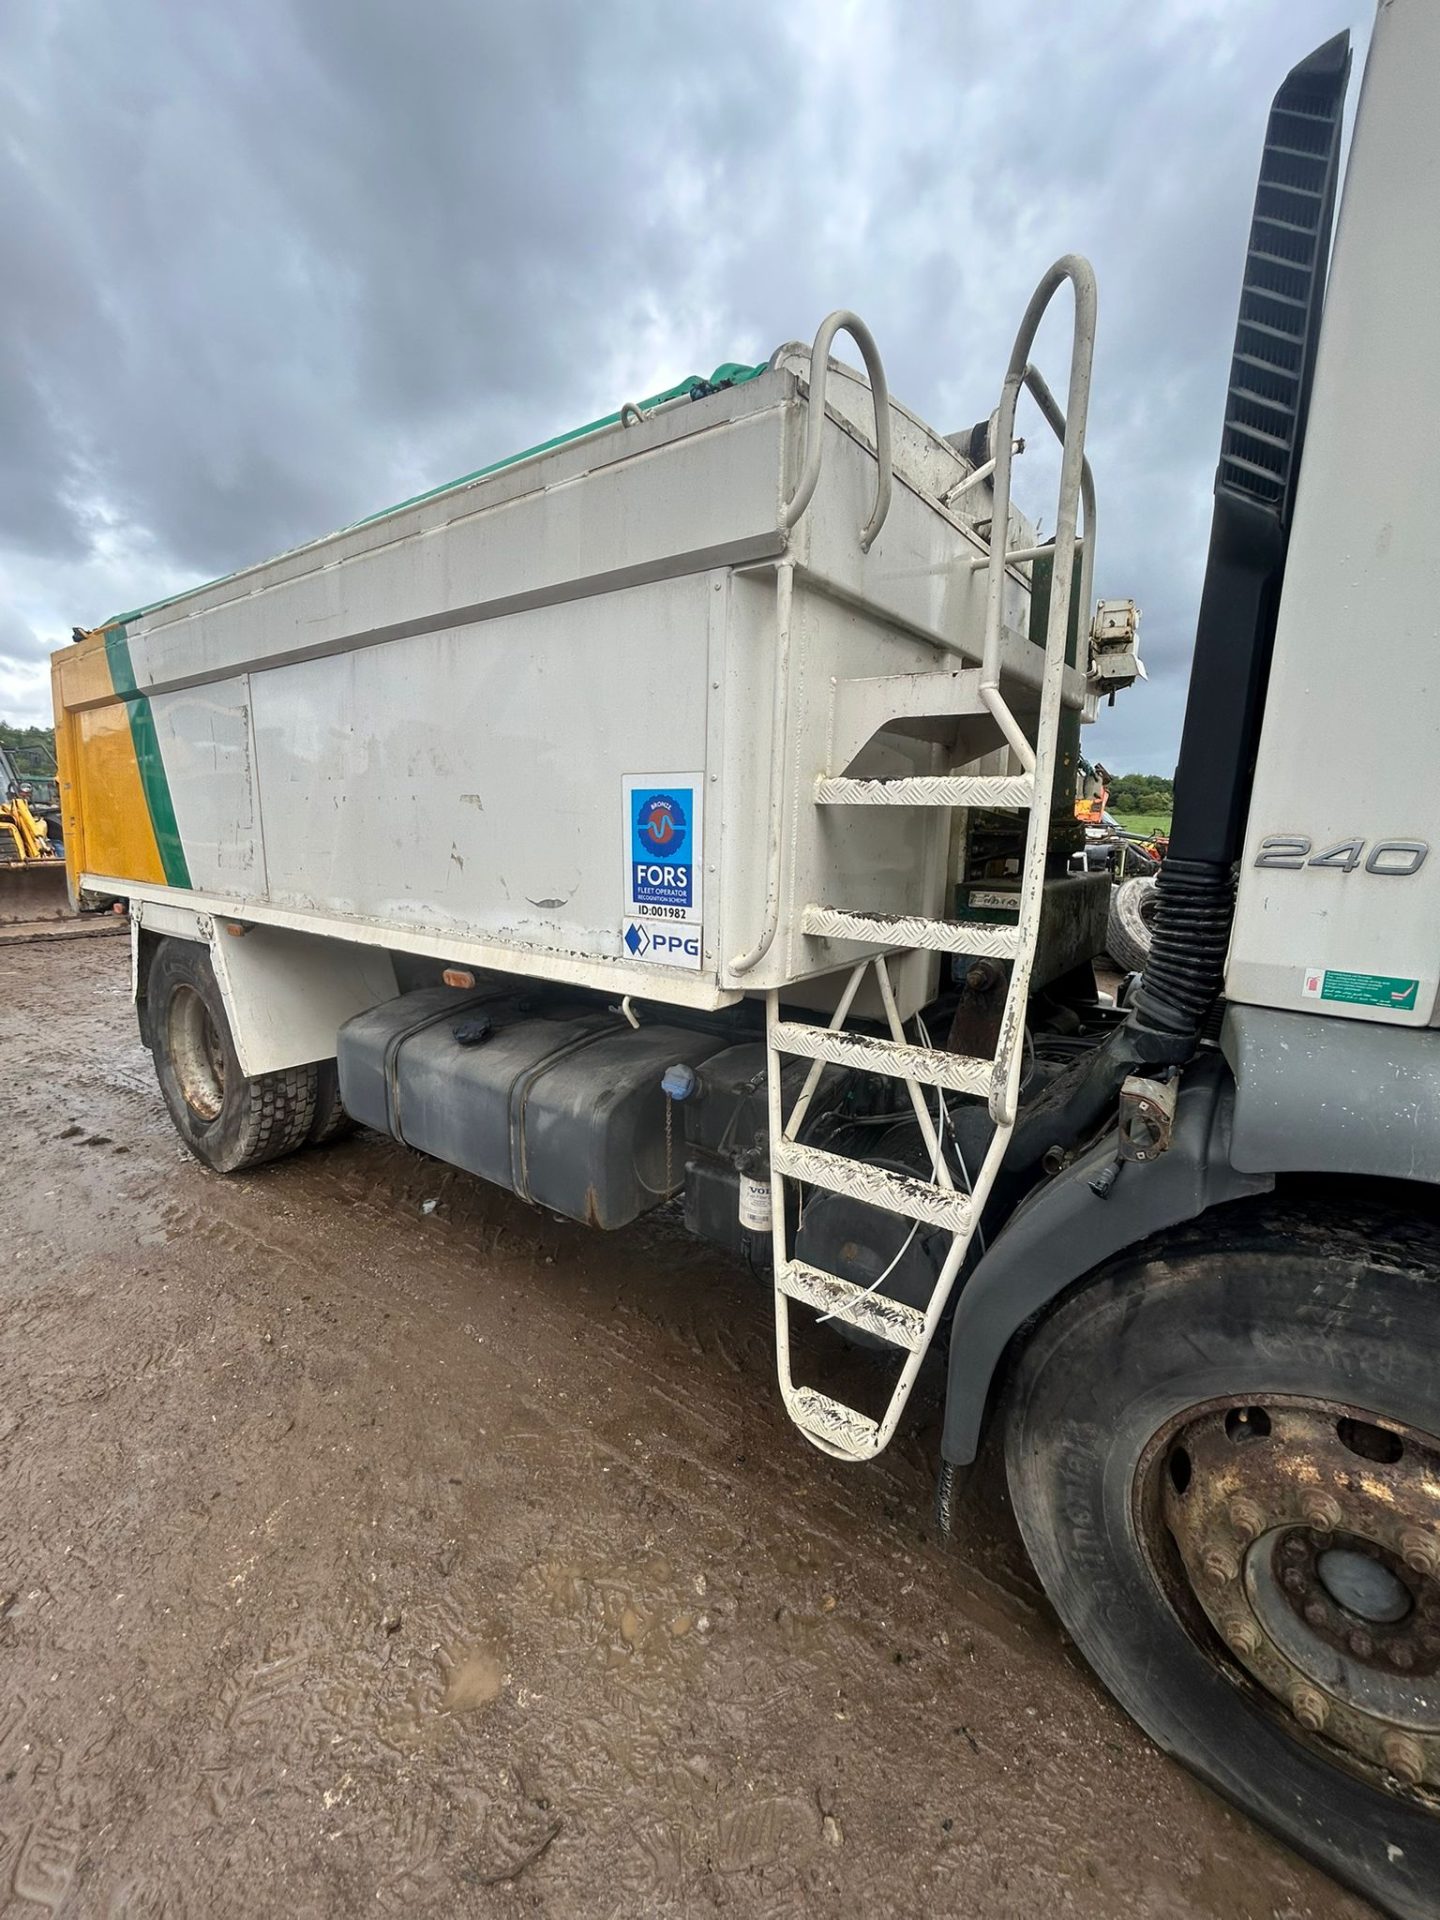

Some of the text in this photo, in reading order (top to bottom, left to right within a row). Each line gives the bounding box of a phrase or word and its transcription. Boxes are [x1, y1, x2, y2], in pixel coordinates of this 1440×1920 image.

[651, 801, 671, 811] BRONZE
[1254, 836, 1429, 876] 240
[637, 864, 688, 888] FORS
[637, 886, 688, 897] FLEET OPERATOR
[637, 894, 688, 904] RECOGNITION SCHEME
[638, 904, 687, 919] ID:001982
[652, 934, 699, 957] PPG
[749, 1186, 771, 1194] VOL
